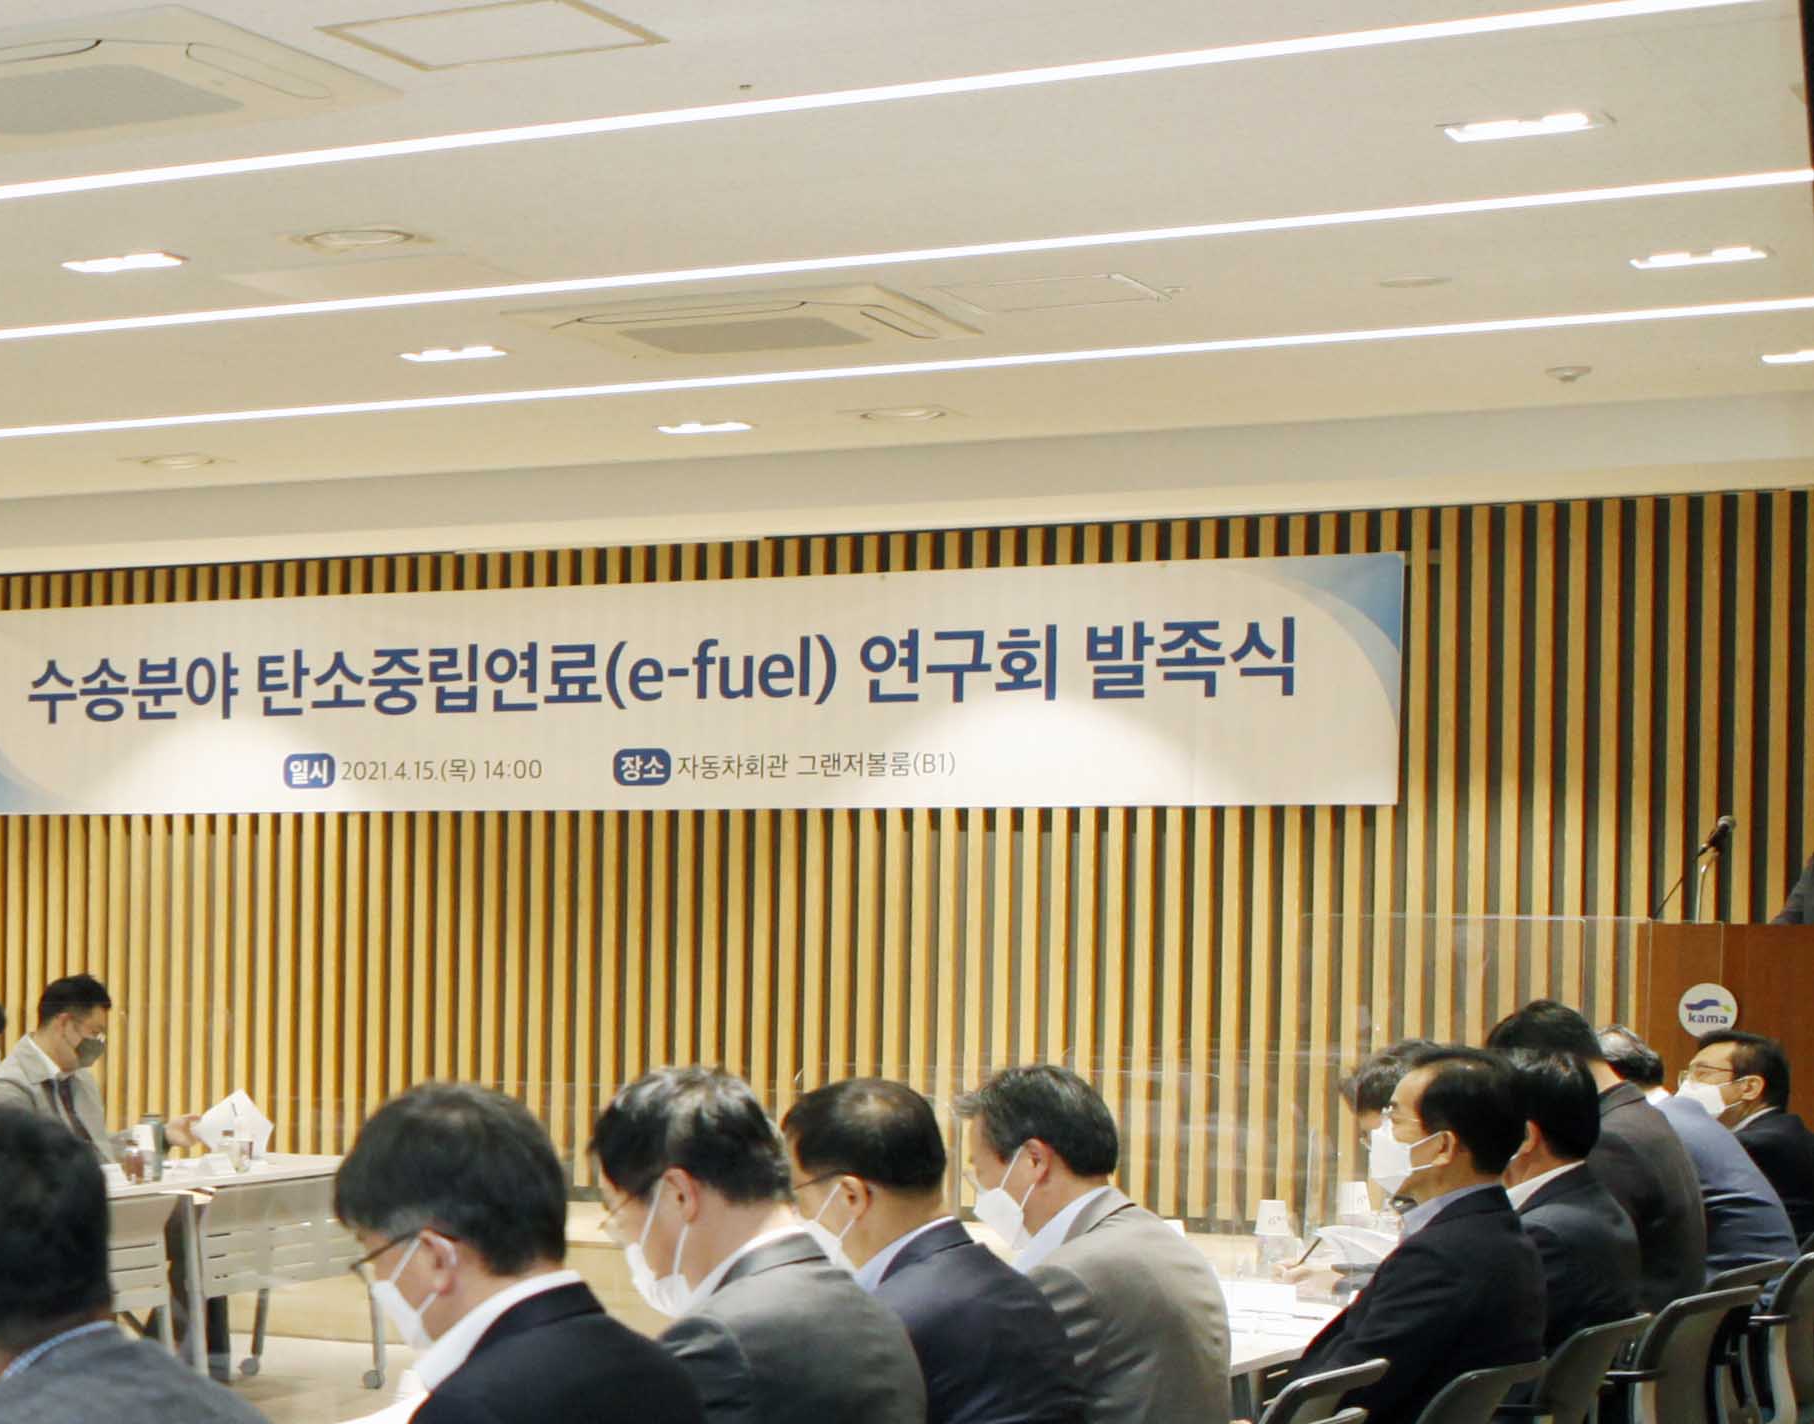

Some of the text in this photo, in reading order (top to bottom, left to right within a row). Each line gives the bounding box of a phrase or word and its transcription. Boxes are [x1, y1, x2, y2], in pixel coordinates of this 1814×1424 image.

[27, 616, 1296, 725] 수송분야 탄소중립연료(e-fuel) 연구회 발족식
[288, 758, 543, 785] 일시 2021.4.15.(목) 14:00
[620, 749, 956, 782] 장소 자동차회관 그랜저볼룸(B1)
[1688, 1012, 1728, 1024] kama
